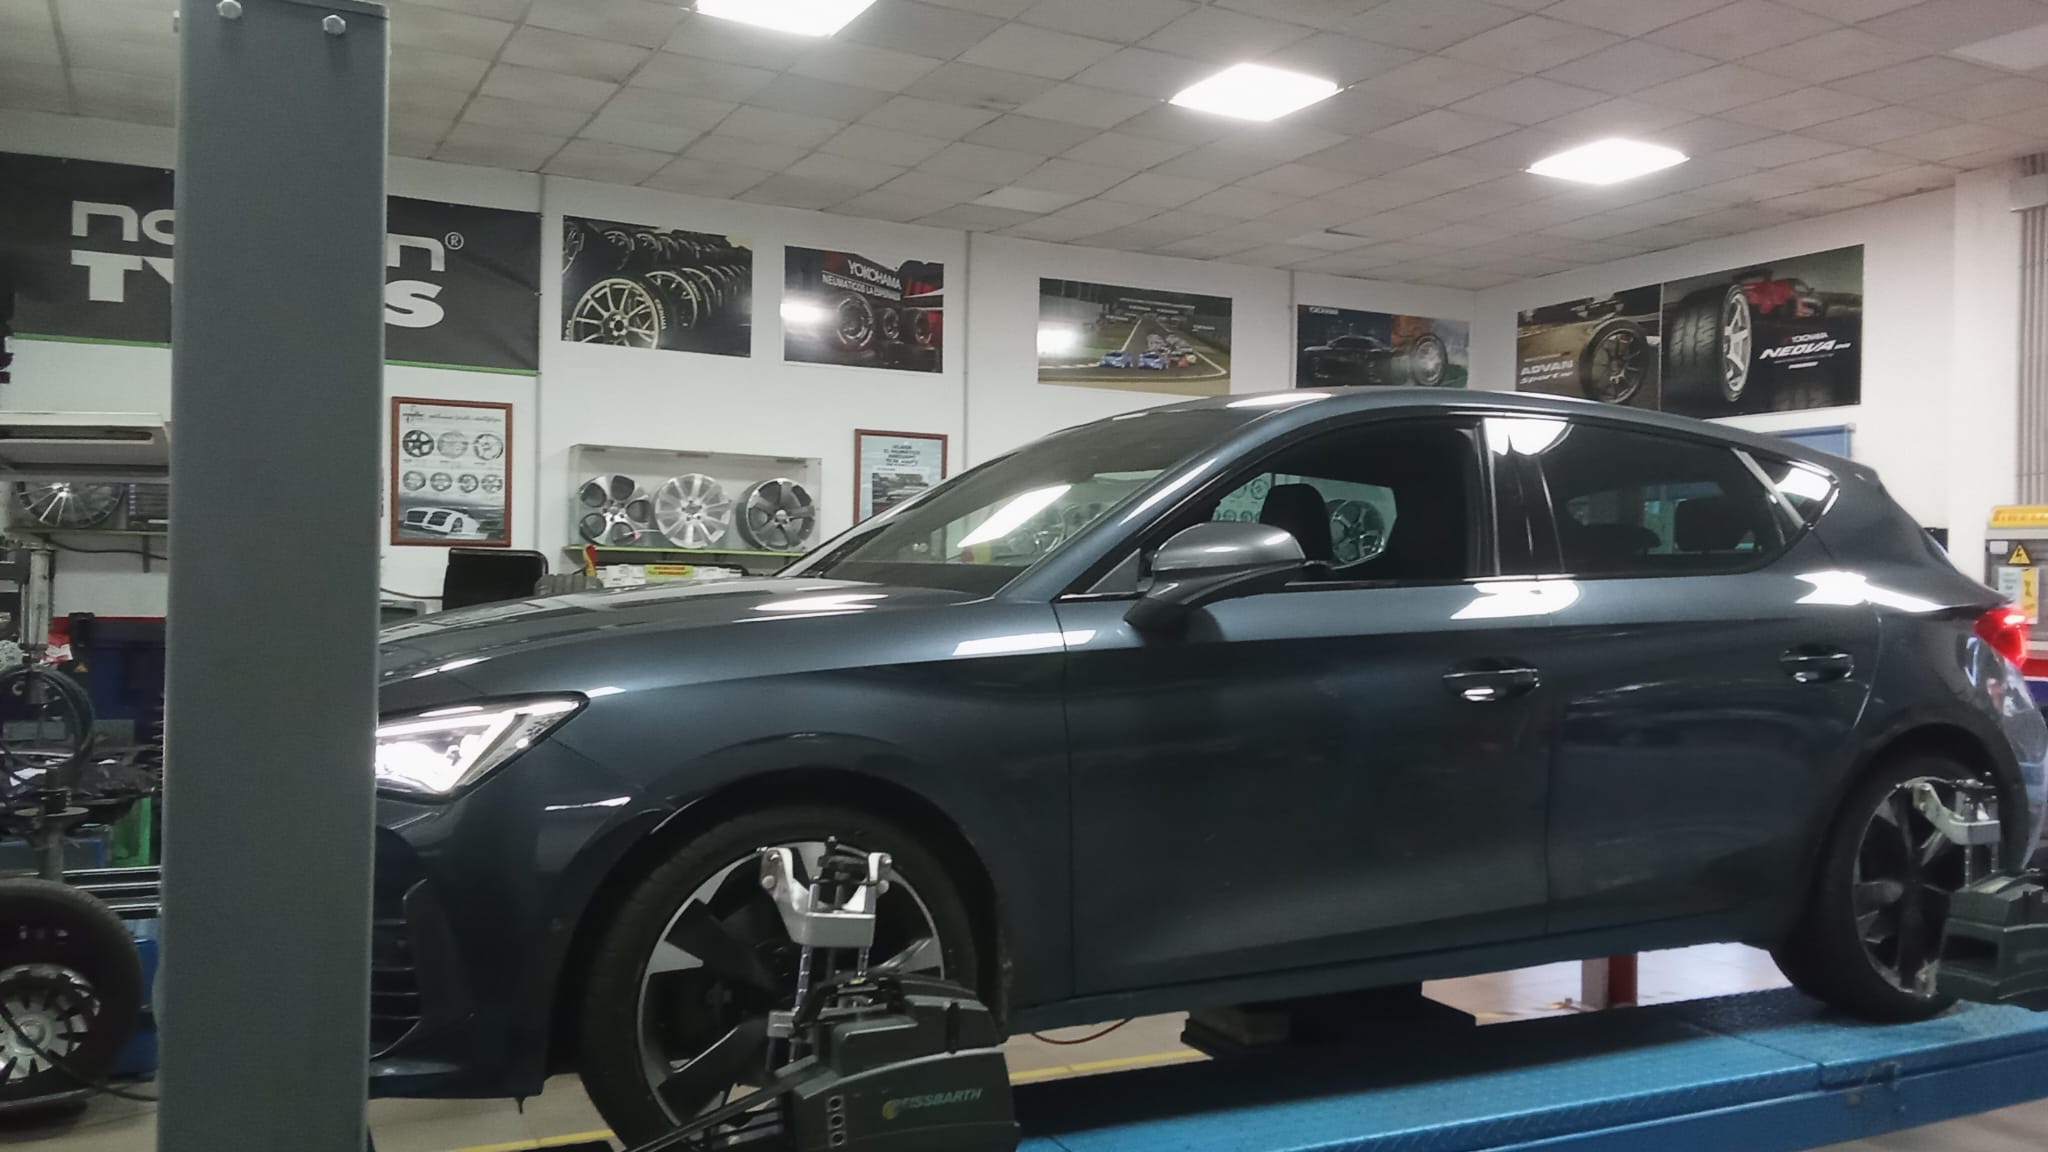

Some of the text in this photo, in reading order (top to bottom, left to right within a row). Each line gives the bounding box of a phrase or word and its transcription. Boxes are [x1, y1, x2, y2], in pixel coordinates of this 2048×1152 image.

[848, 259, 902, 290] YOKOHAMA
[1759, 339, 1837, 360] NEOVA
[1519, 360, 1574, 376] ADVAN
